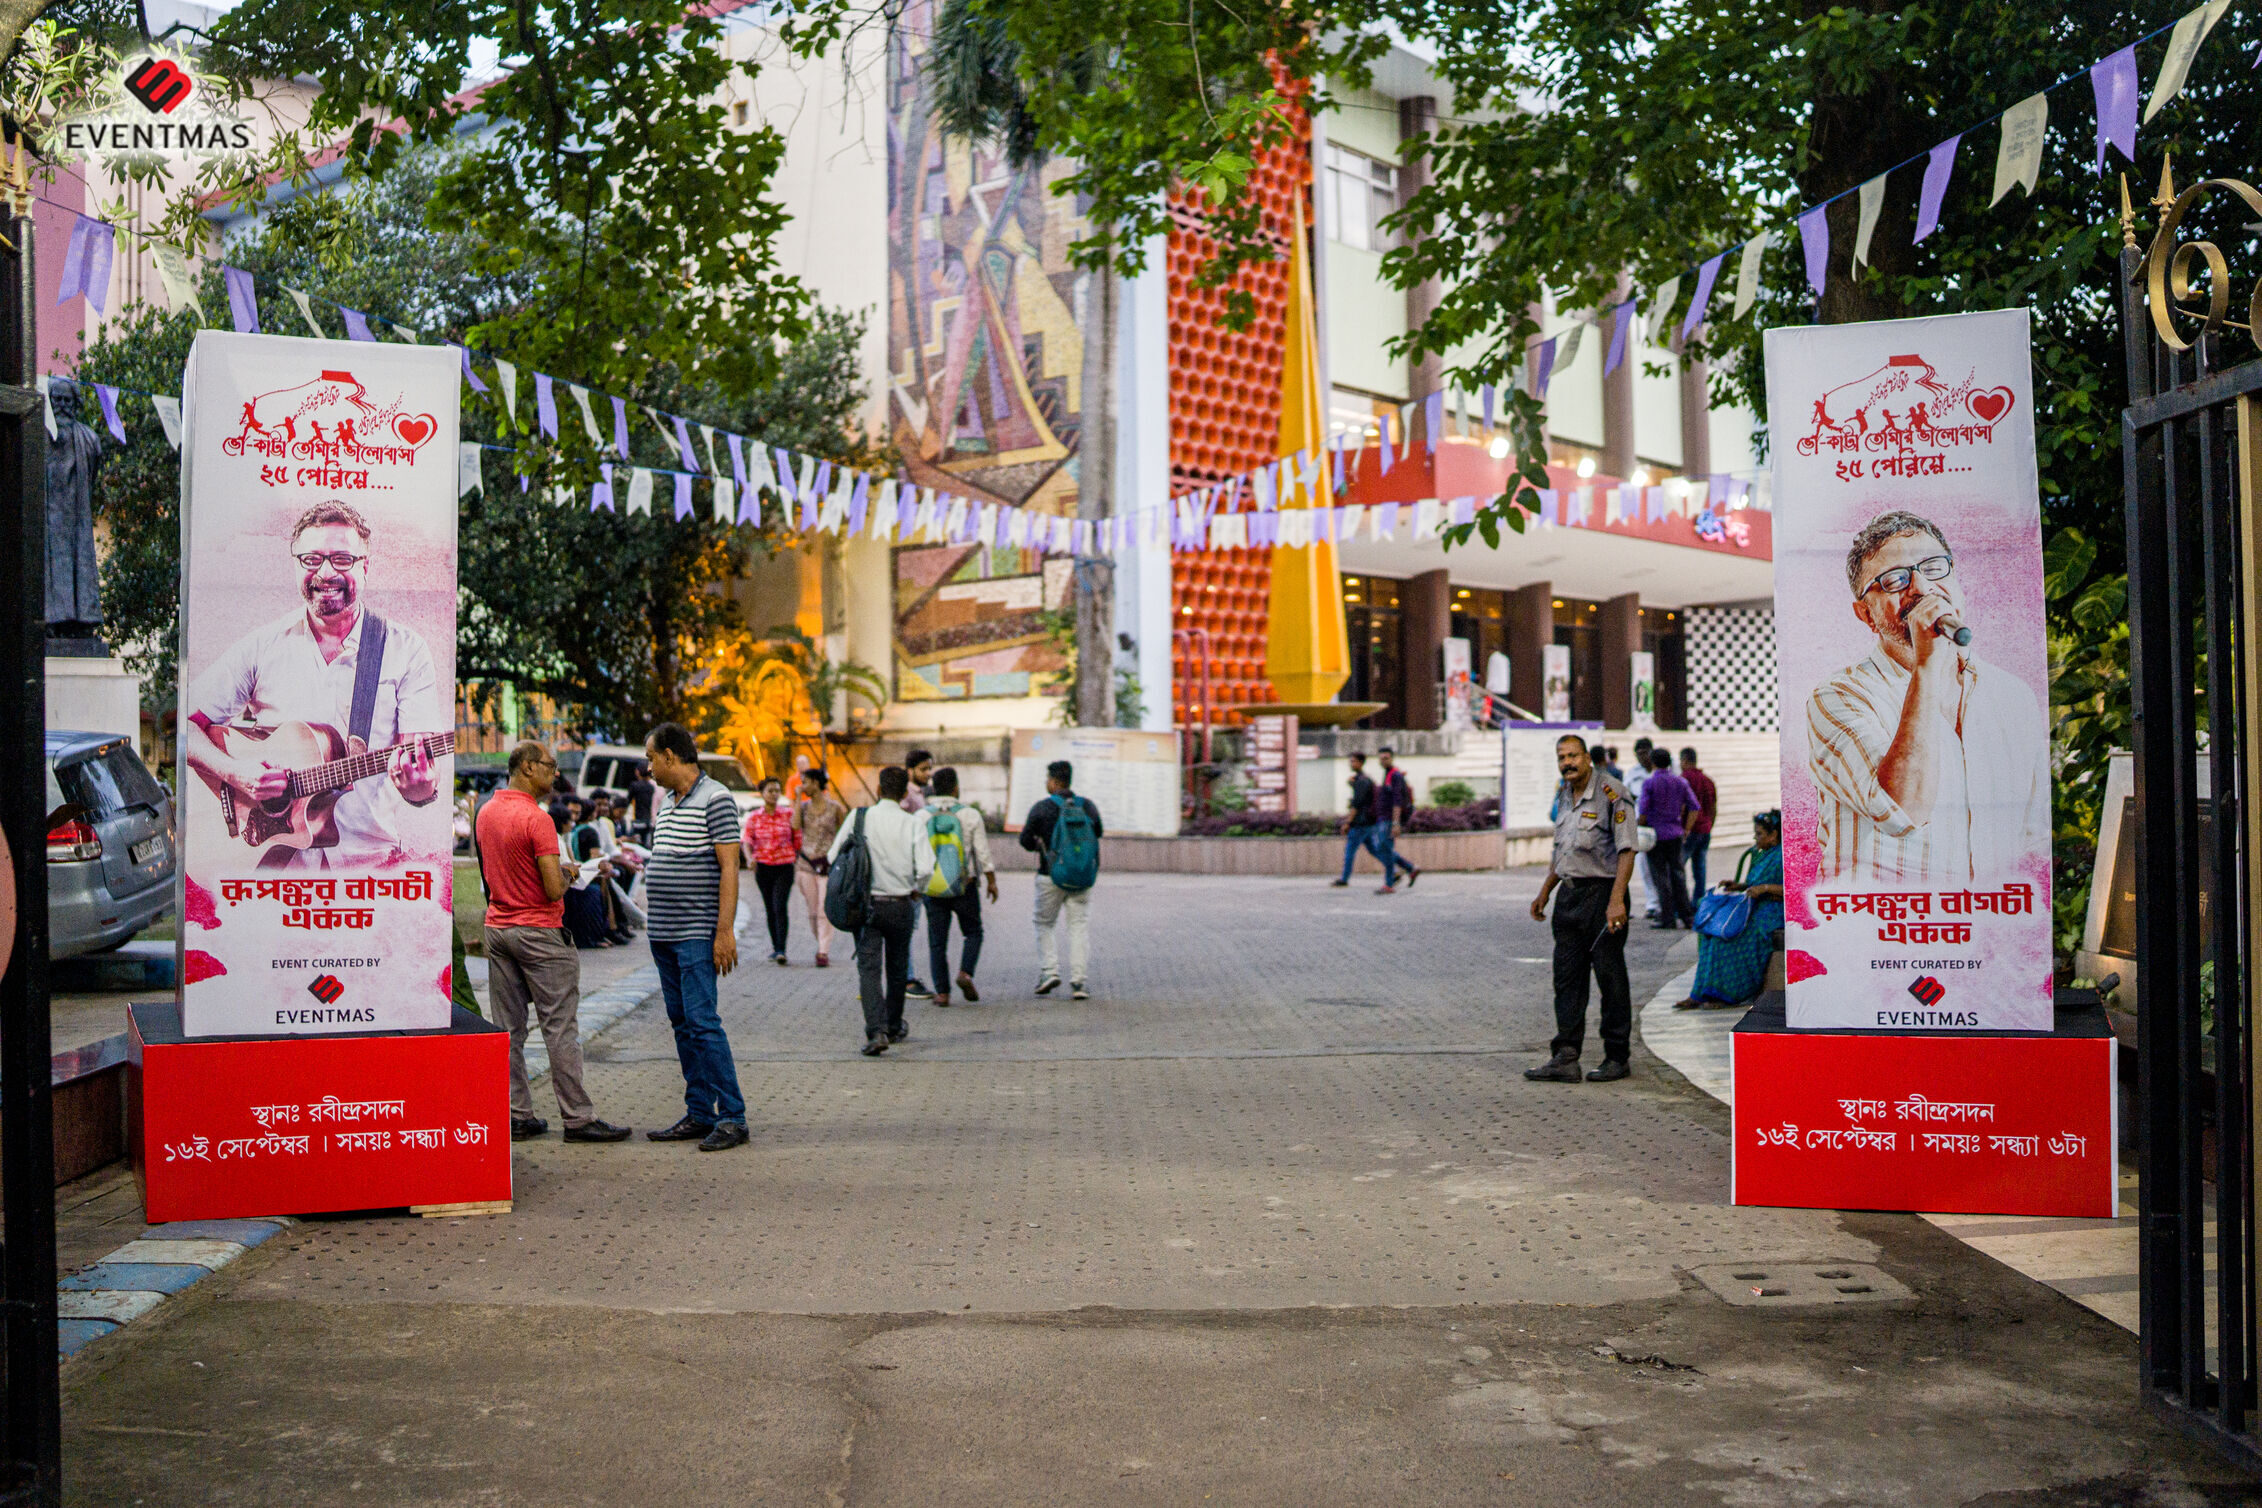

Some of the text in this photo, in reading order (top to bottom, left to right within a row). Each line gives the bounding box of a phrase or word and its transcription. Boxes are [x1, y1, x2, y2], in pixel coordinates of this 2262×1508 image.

[1864, 427, 1914, 453] তোমার
[1917, 424, 1994, 447] ভালোবাসা
[292, 440, 341, 461] তোমার
[343, 444, 416, 466] ভালোবাসা
[260, 464, 289, 487] ২৫
[1836, 459, 1864, 482] ২৫
[220, 871, 434, 908] রূপঙ্কর বাগচী
[1815, 883, 2034, 921] রূপঙ্কর বাগচী
[282, 908, 375, 930] একক
[1878, 922, 1973, 945] একক
[271, 957, 381, 969] EVENT CURATED BY
[1870, 959, 1983, 970] EVENT CURATED BY
[275, 1008, 375, 1025] EVENTMAS
[1877, 1011, 1979, 1027] EVENTMAS
[307, 1095, 406, 1123] রবীন্দ্রসদন
[1894, 1093, 1995, 1123] রবীন্দ্রসদন
[164, 1133, 212, 1162] ১৬ই
[217, 1131, 310, 1160] সেপ্টেম্বর
[399, 1127, 447, 1150] সন্ধ্যা
[453, 1121, 489, 1146] ৬টা
[1755, 1121, 1801, 1151] ১৬ই
[1806, 1124, 1897, 1151] সেপ্টেম্বর
[1988, 1135, 2040, 1157] সন্ধ্যা
[2047, 1130, 2087, 1157] ৬টা
